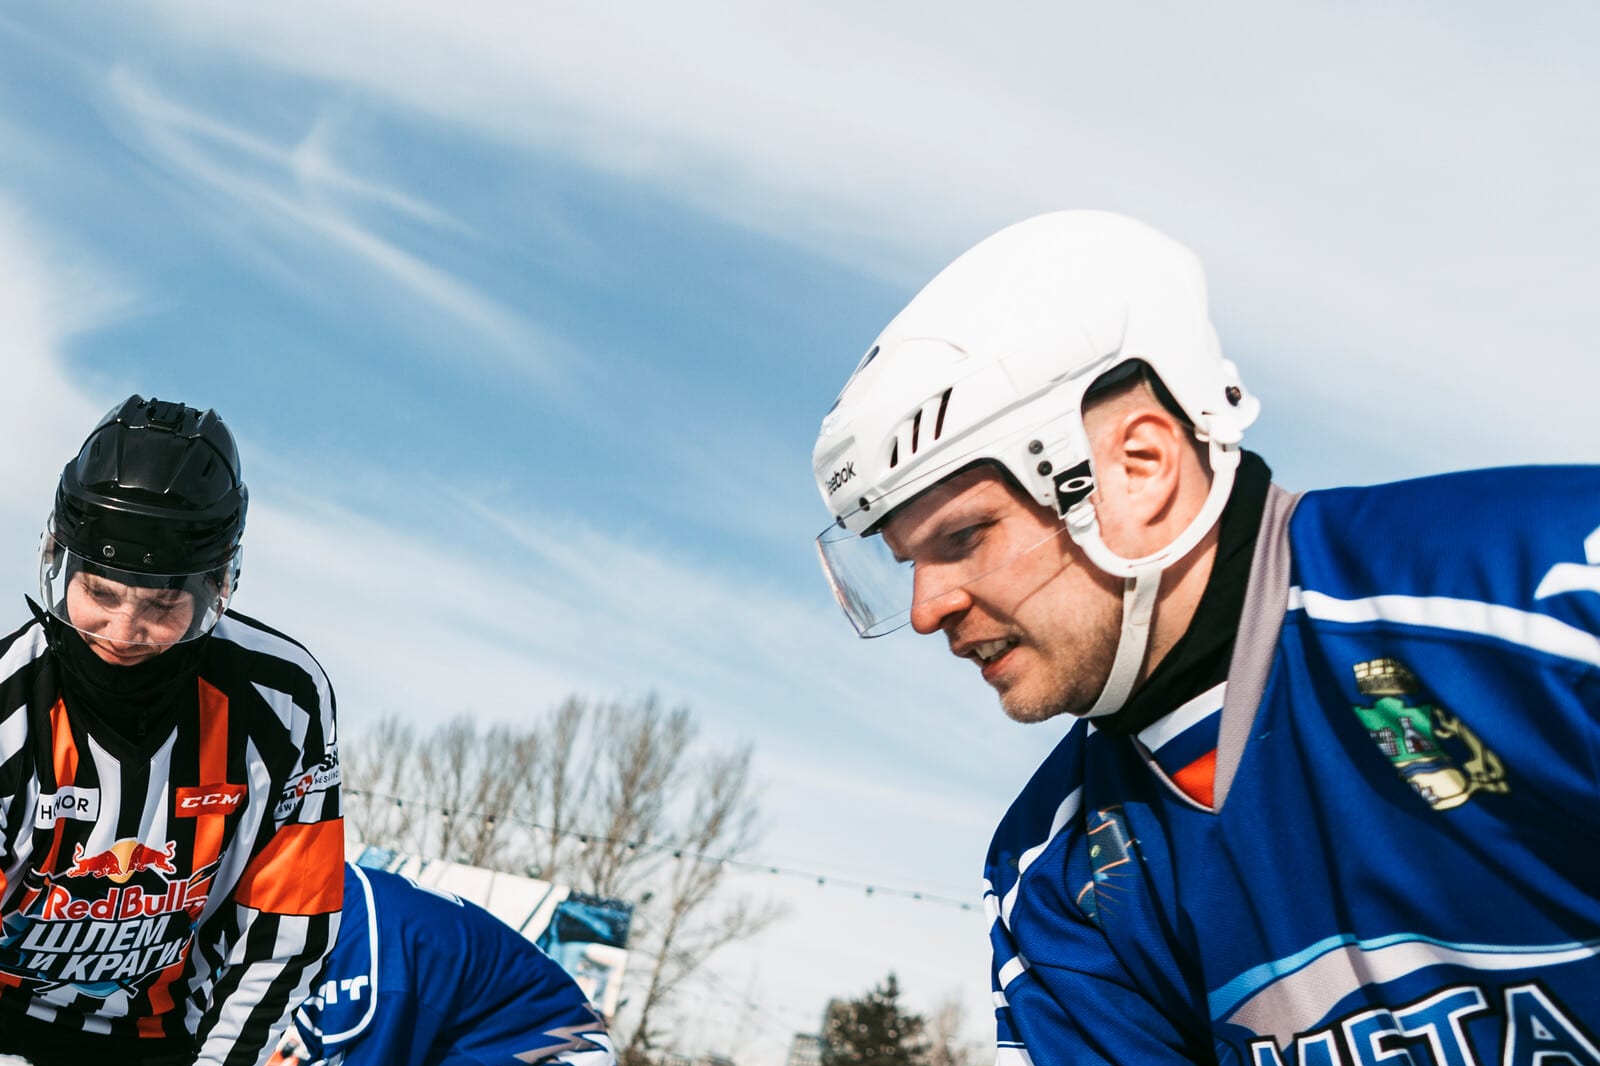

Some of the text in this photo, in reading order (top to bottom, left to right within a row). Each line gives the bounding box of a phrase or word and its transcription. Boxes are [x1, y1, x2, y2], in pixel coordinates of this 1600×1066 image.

[180, 792, 242, 809] CCM
[43, 880, 188, 920] Red Bull
[21, 915, 172, 953] ШЛЕМ
[27, 952, 56, 971] И
